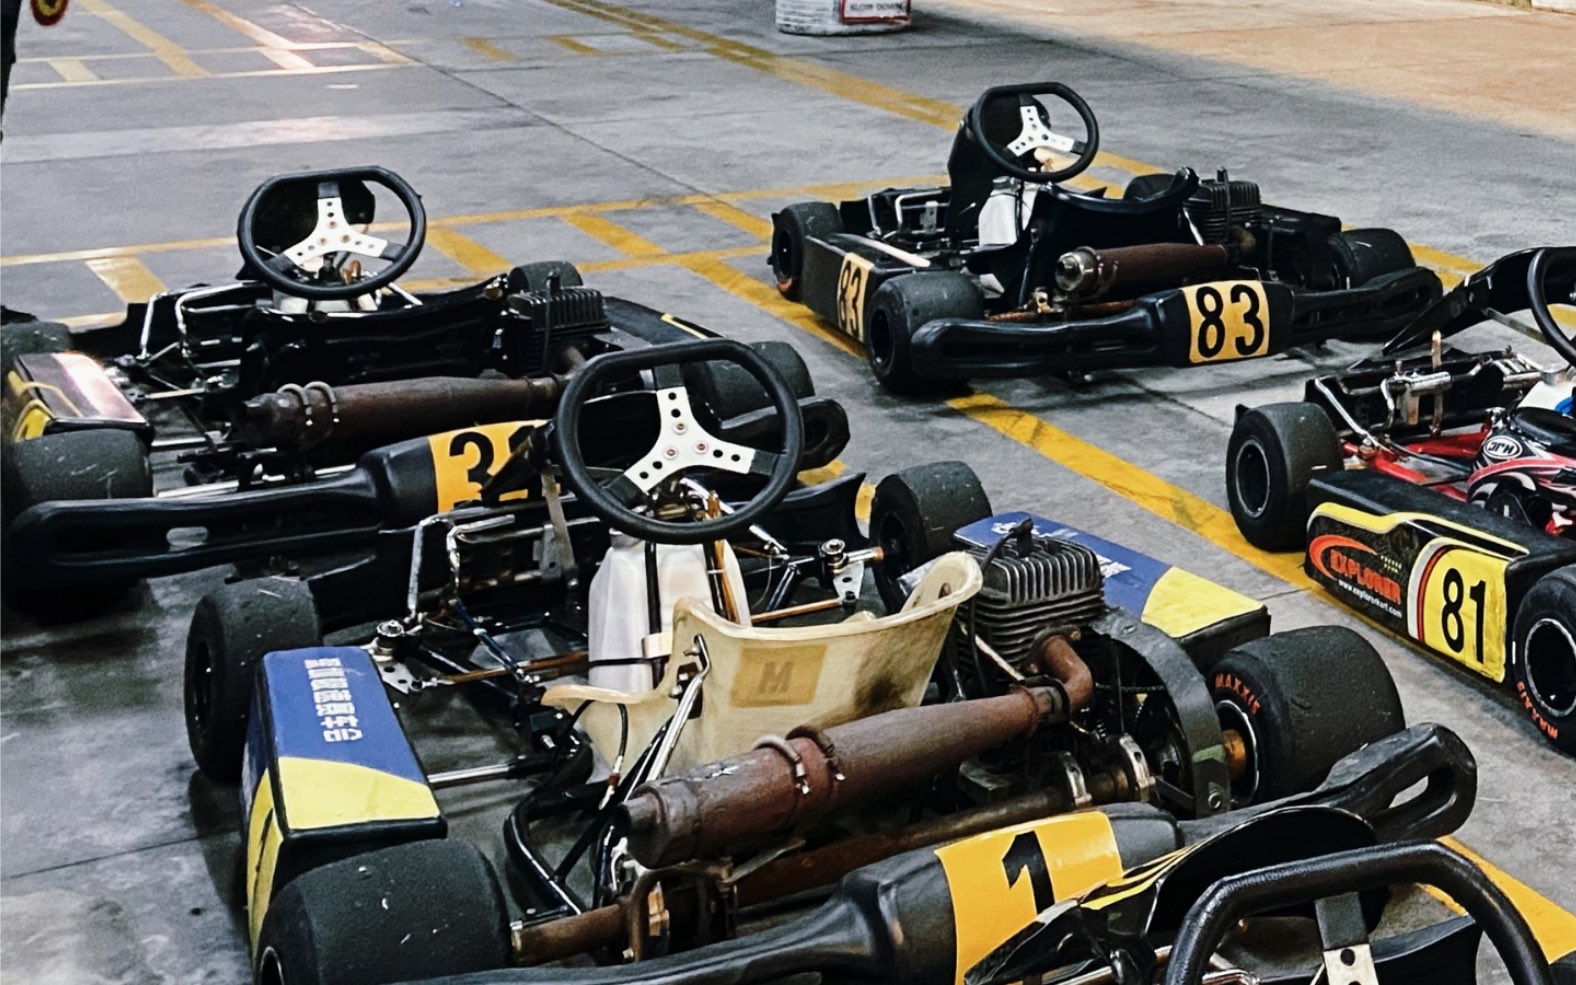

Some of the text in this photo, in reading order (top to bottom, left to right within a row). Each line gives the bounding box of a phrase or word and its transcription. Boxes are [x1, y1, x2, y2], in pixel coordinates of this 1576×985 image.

[841, 260, 862, 339] 83
[1196, 284, 1264, 358] 83
[1441, 567, 1486, 664] 81
[1002, 830, 1056, 916] 1
